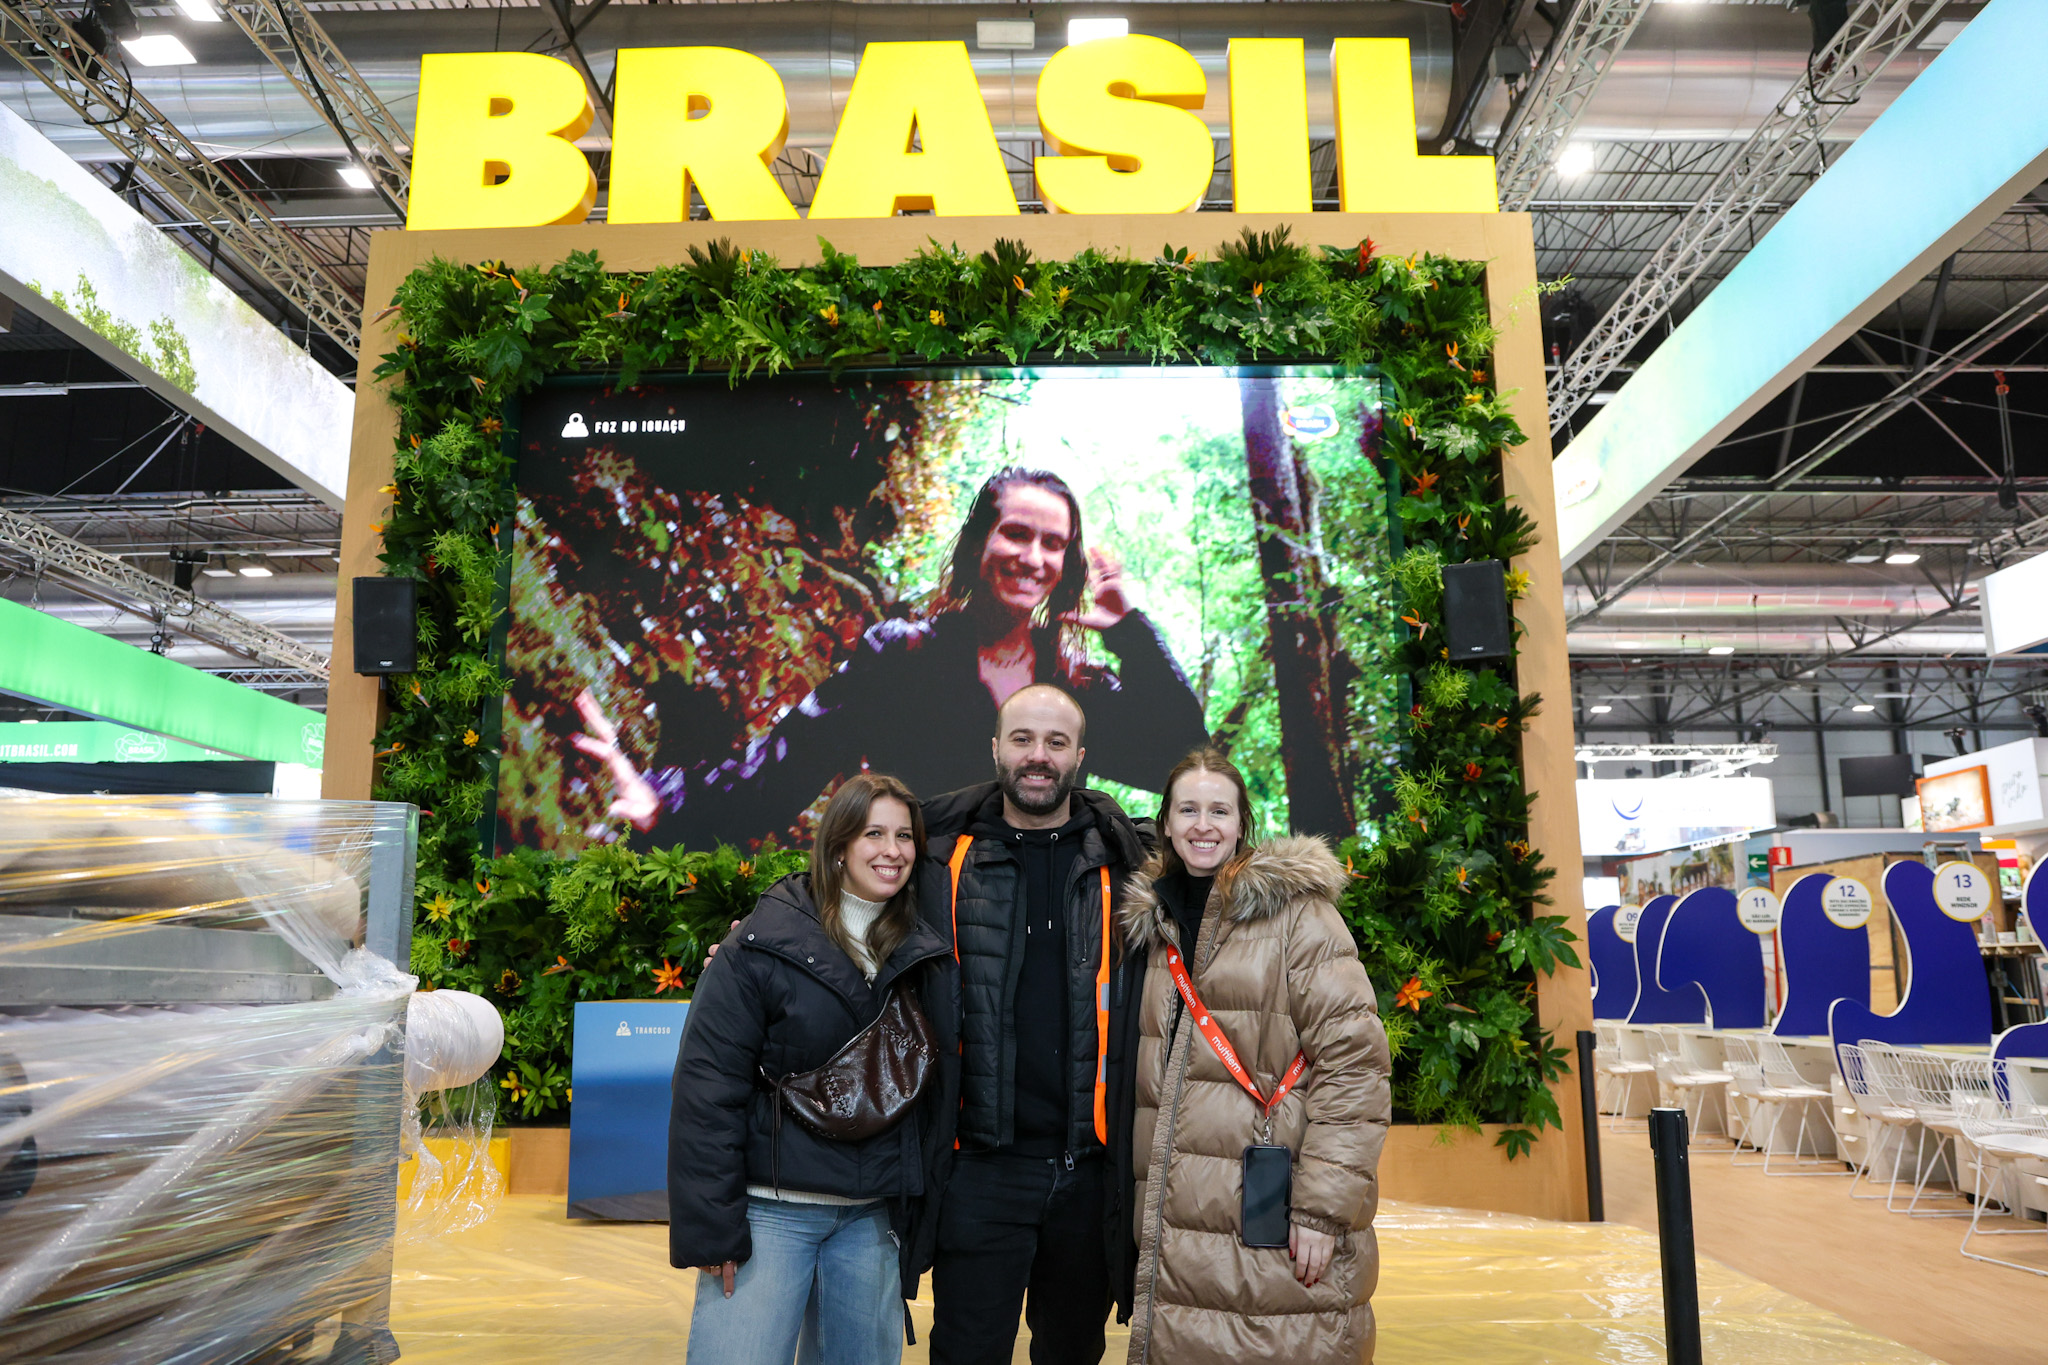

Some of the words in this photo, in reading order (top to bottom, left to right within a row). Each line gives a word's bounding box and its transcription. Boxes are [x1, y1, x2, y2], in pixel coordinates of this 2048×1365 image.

[406, 34, 1499, 231] BRASIL
[594, 421, 617, 434] FOZ
[621, 420, 638, 433] DO
[127, 745, 156, 755] BRASIL
[1953, 874, 1973, 888] 13
[1839, 885, 1857, 898] 12
[1753, 897, 1767, 908] 11
[1176, 973, 1197, 1009] multilem
[634, 1026, 671, 1035] TRANCOSO
[1211, 1035, 1242, 1074] multilem
[1292, 1052, 1306, 1077] mult
